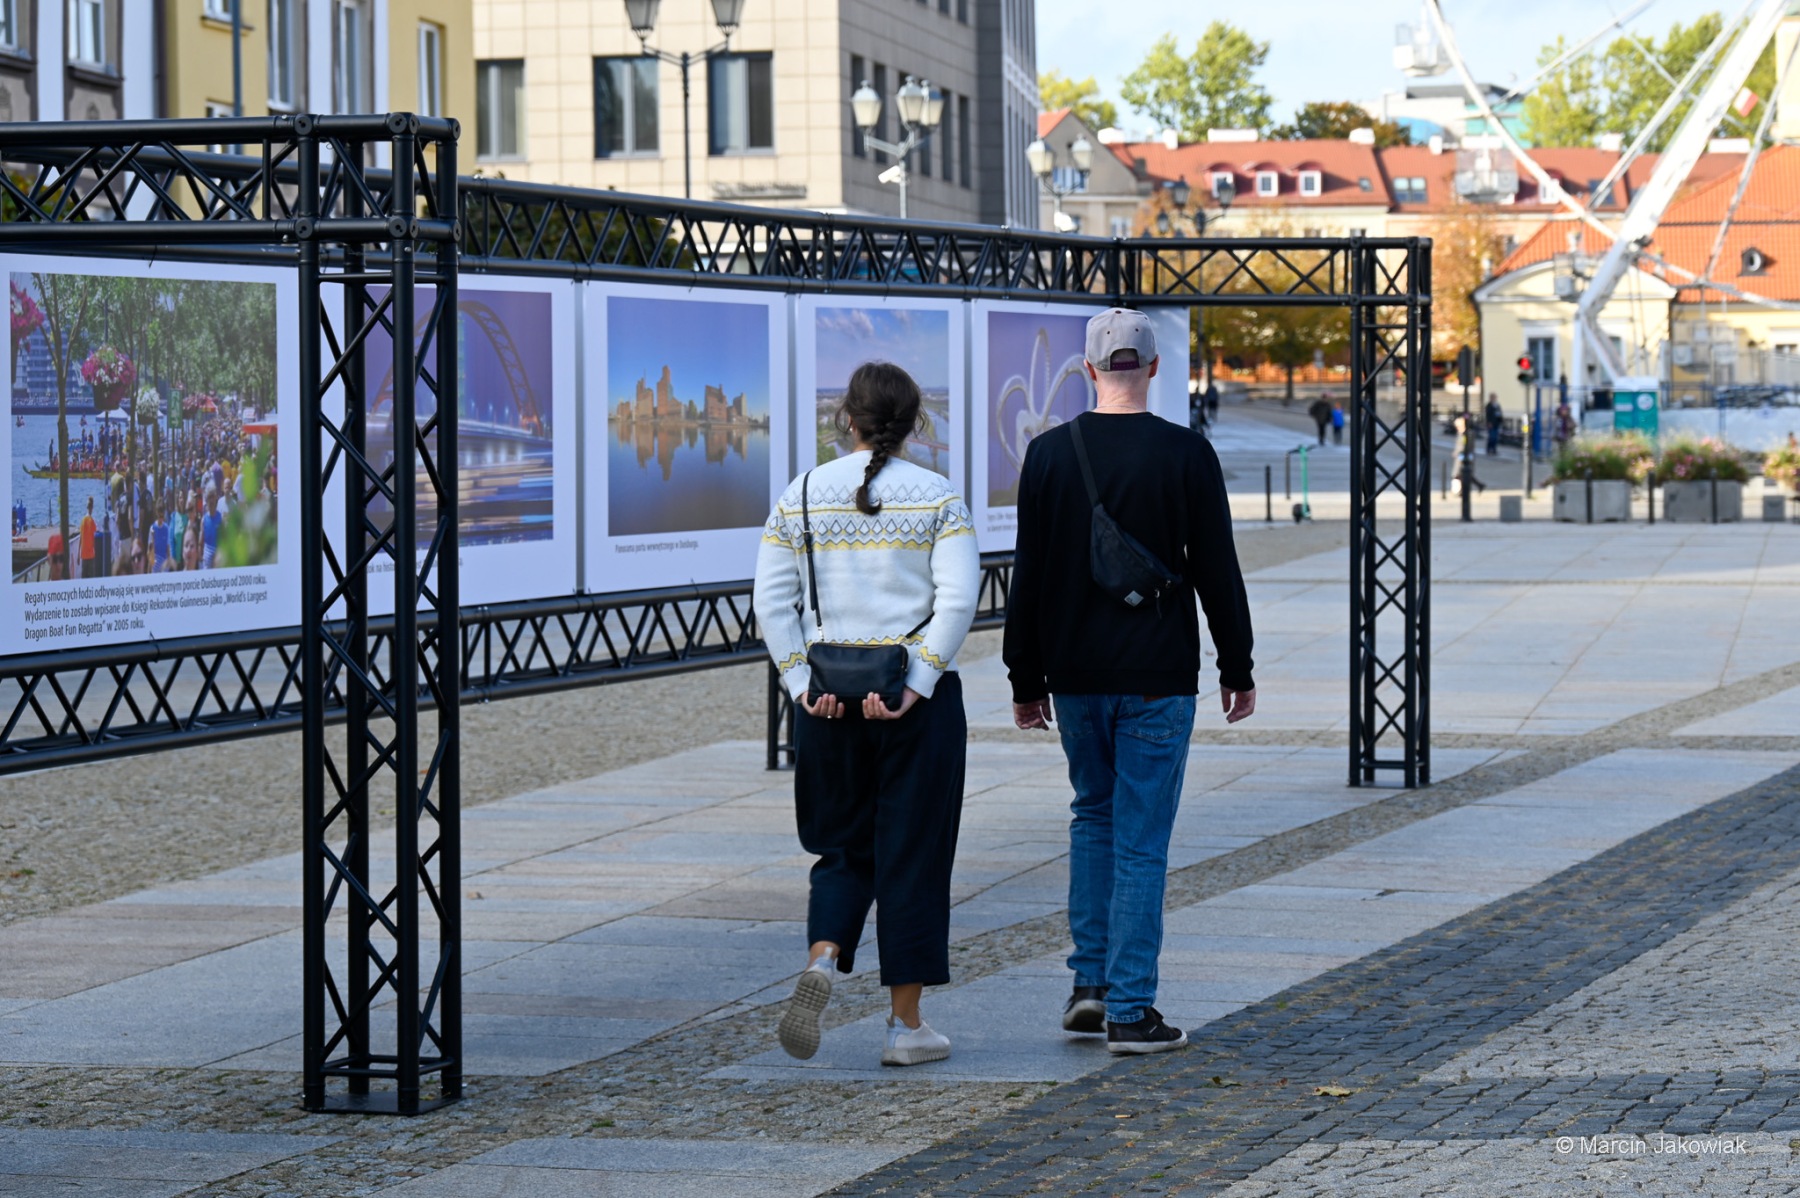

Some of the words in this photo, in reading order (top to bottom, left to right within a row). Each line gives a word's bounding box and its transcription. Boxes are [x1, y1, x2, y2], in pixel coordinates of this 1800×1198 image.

[25, 592, 47, 606] Regaty
[48, 588, 77, 603] smoczych
[78, 587, 94, 600] łodzi
[95, 585, 125, 599] odbywają
[125, 584, 134, 597] się
[135, 586, 140, 594] w
[141, 581, 182, 595] wewnętrznym
[182, 579, 201, 593] porcie
[201, 577, 230, 590] Duisburga
[230, 575, 238, 587] od
[238, 575, 252, 586] 2000
[253, 574, 267, 585] roku.
[25, 608, 61, 624] Wydarzenie
[63, 607, 70, 618] to
[71, 605, 93, 617] zostało
[95, 603, 120, 617] wpisane
[122, 601, 130, 613] do
[131, 600, 149, 614] Księgi
[150, 597, 178, 610] Rekordów
[180, 595, 209, 608] Guinnessa
[210, 593, 223, 607] jako
[247, 591, 267, 604] Largest
[25, 628, 48, 641] Dragon
[49, 625, 63, 637] Boat
[65, 624, 76, 636] Fun
[107, 622, 112, 631] w
[114, 619, 129, 631] 2005
[130, 617, 145, 629] roku.
